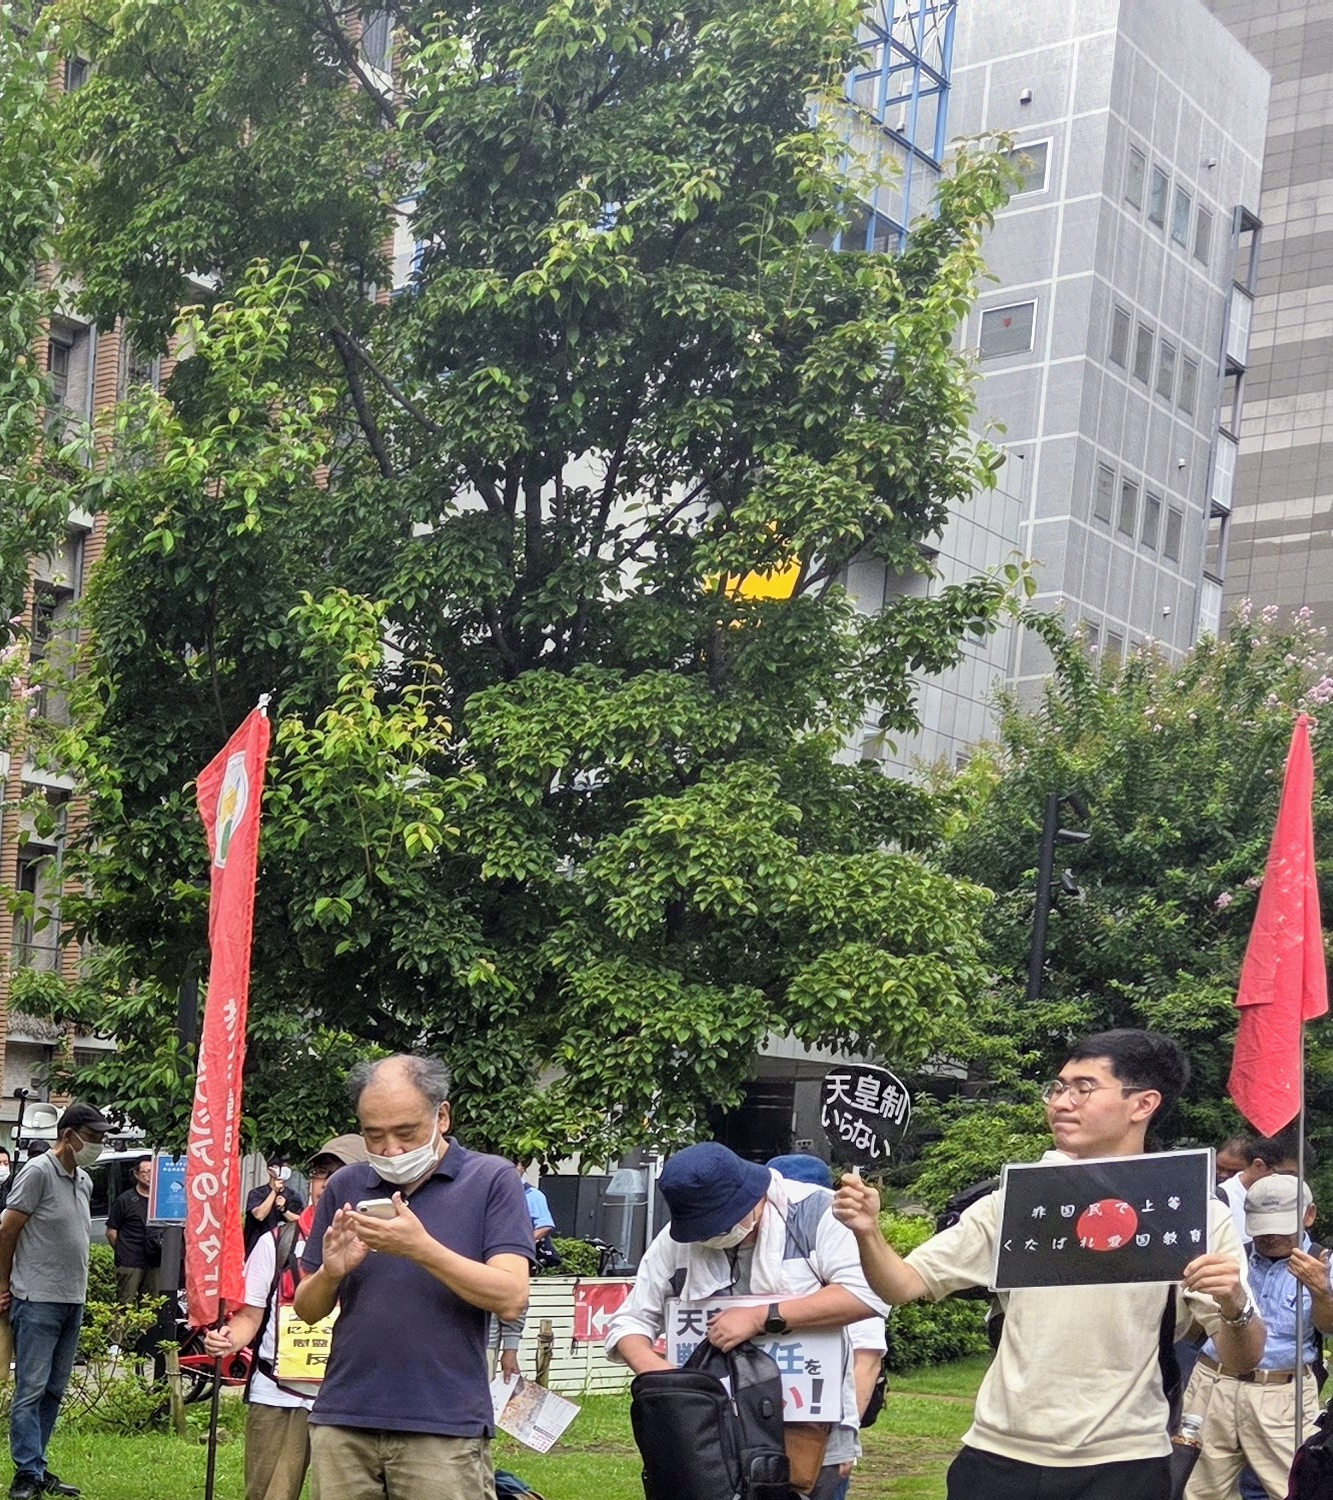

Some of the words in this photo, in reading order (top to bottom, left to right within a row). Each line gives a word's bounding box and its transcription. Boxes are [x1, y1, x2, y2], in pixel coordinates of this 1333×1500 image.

[825, 1074, 905, 1125] 天皇制
[821, 1104, 891, 1159] いらない
[1031, 1195, 1182, 1219] 非国民で上等
